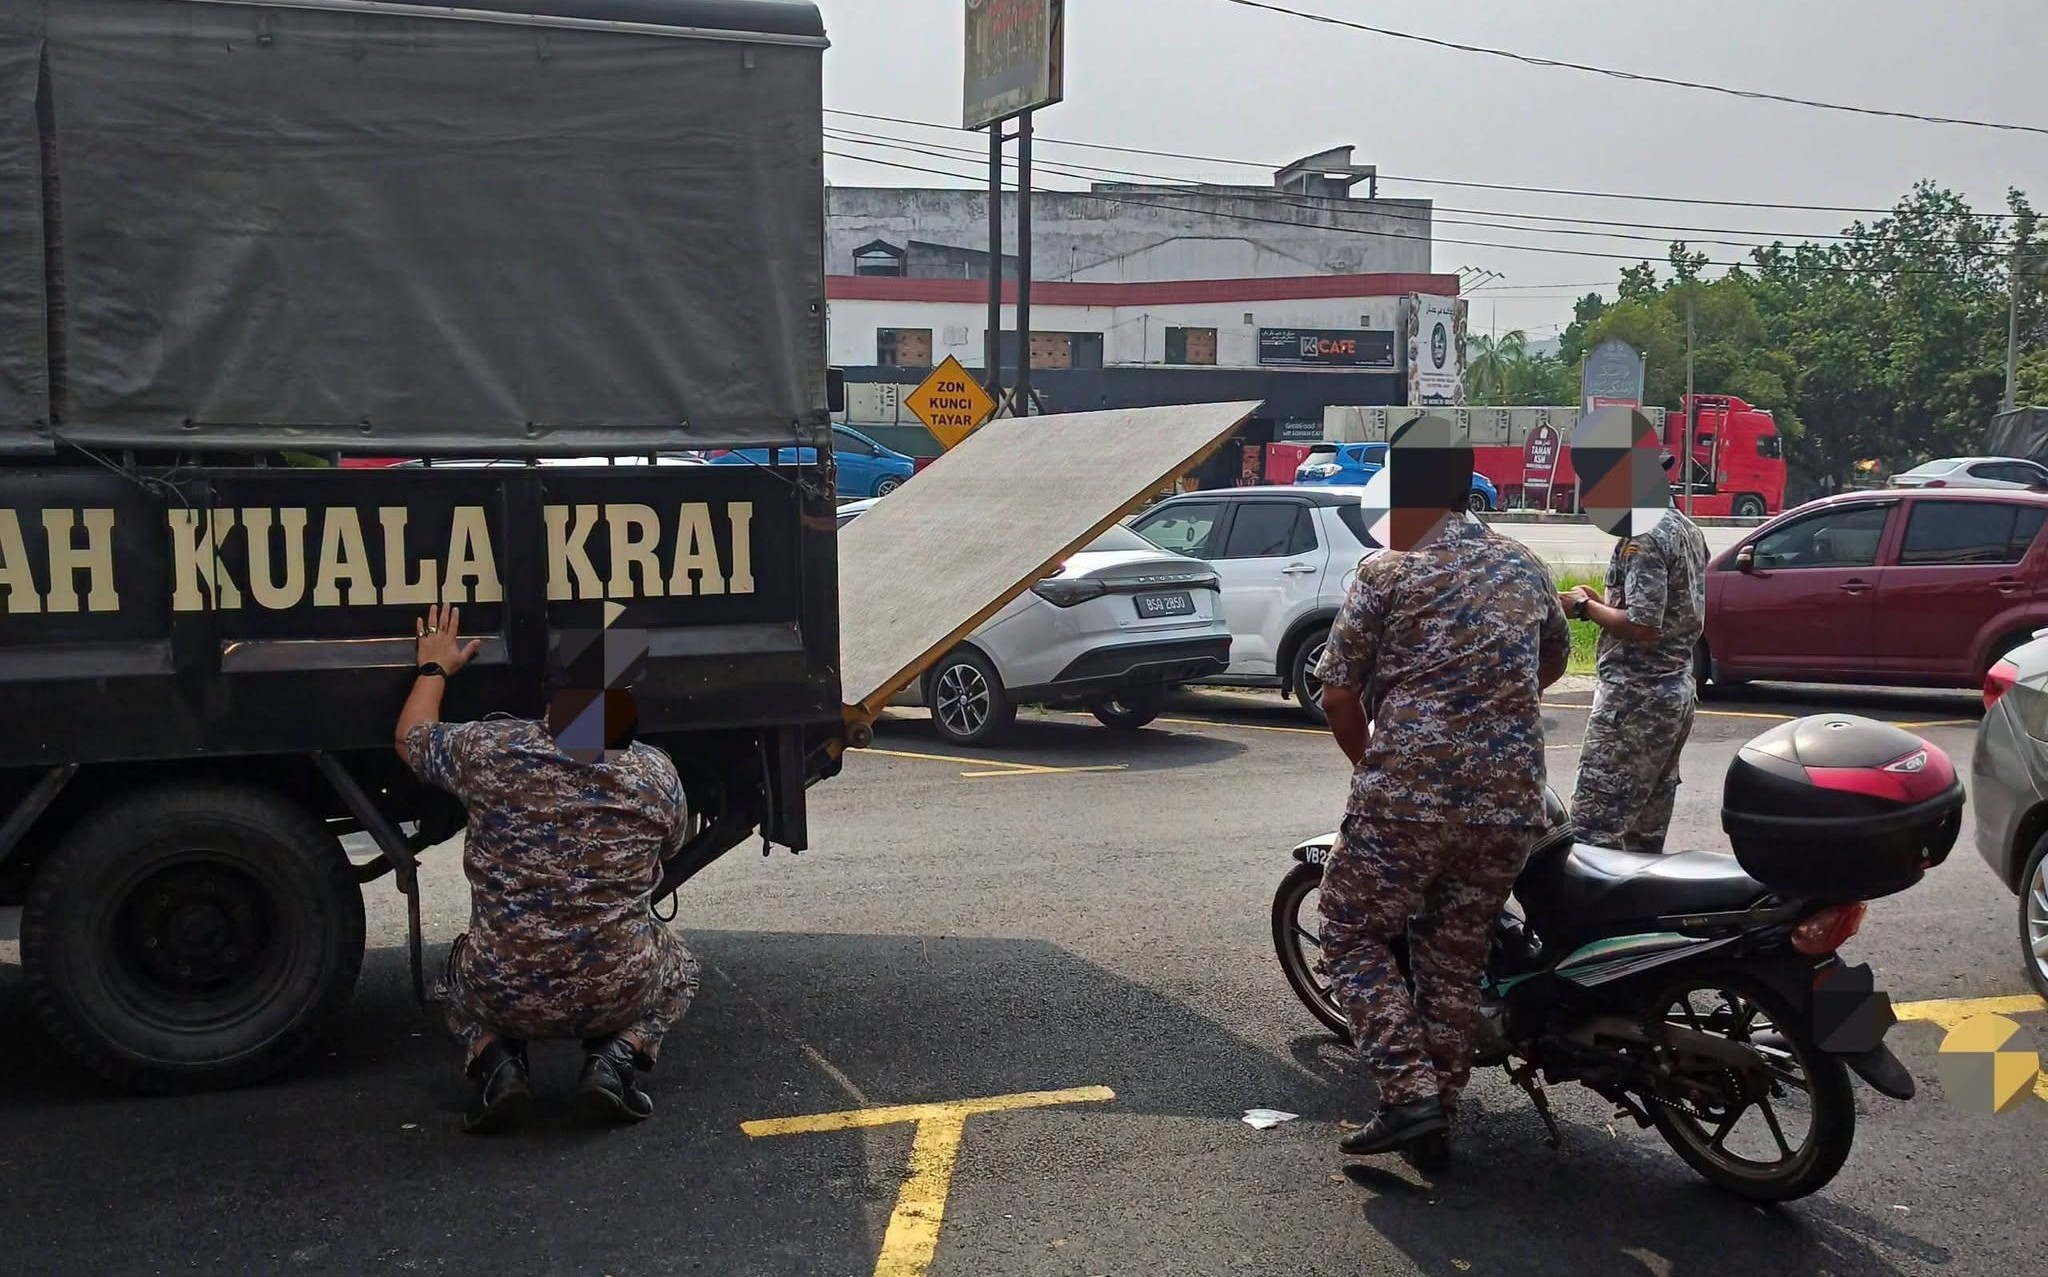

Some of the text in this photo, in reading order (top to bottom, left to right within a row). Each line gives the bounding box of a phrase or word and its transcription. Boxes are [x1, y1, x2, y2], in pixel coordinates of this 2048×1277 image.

[1319, 338, 1356, 354] CAFE
[937, 381, 965, 393] ZON
[929, 398, 972, 410] KUNCI
[930, 414, 972, 426] TAYAR
[1285, 422, 1316, 430] GrabFood
[1532, 445, 1552, 456] TAMAN
[168, 506, 504, 611] KUALA
[544, 502, 755, 600] KRAI
[1164, 597, 1185, 610] 2850
